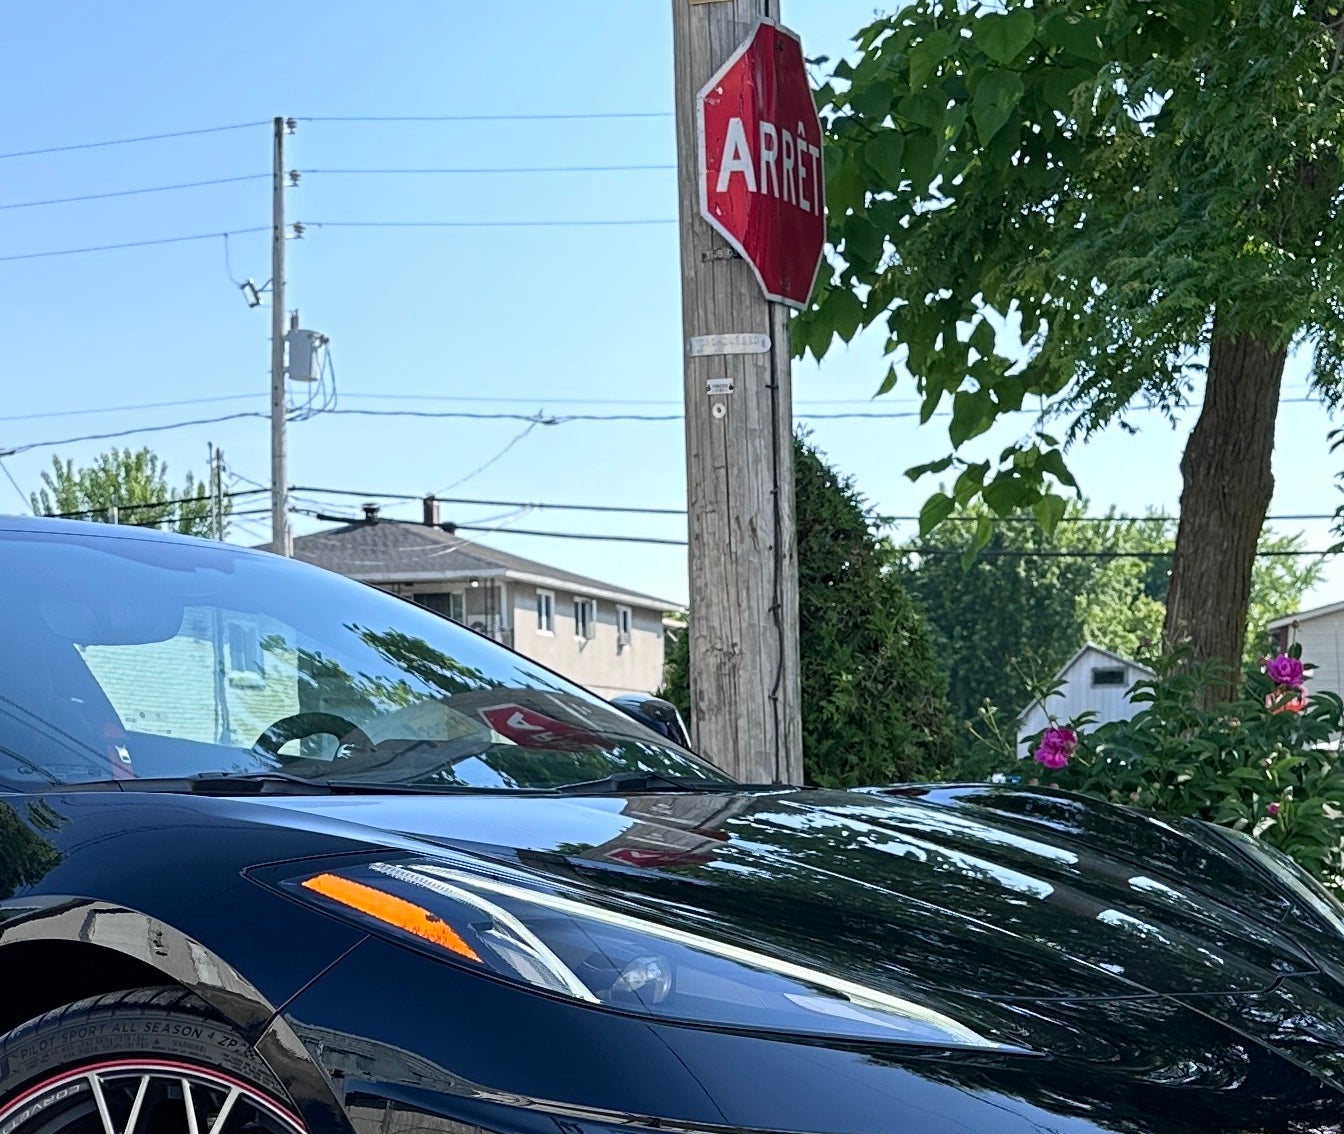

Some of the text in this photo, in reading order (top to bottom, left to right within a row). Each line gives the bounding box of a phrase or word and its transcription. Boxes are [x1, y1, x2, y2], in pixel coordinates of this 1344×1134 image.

[716, 117, 819, 217] ARRÊT
[21, 1037, 56, 1060] PILOT
[62, 1023, 105, 1044] SPORT
[112, 1022, 137, 1033] ALL
[144, 1021, 202, 1039] SEASON
[218, 1036, 238, 1047] ZP
